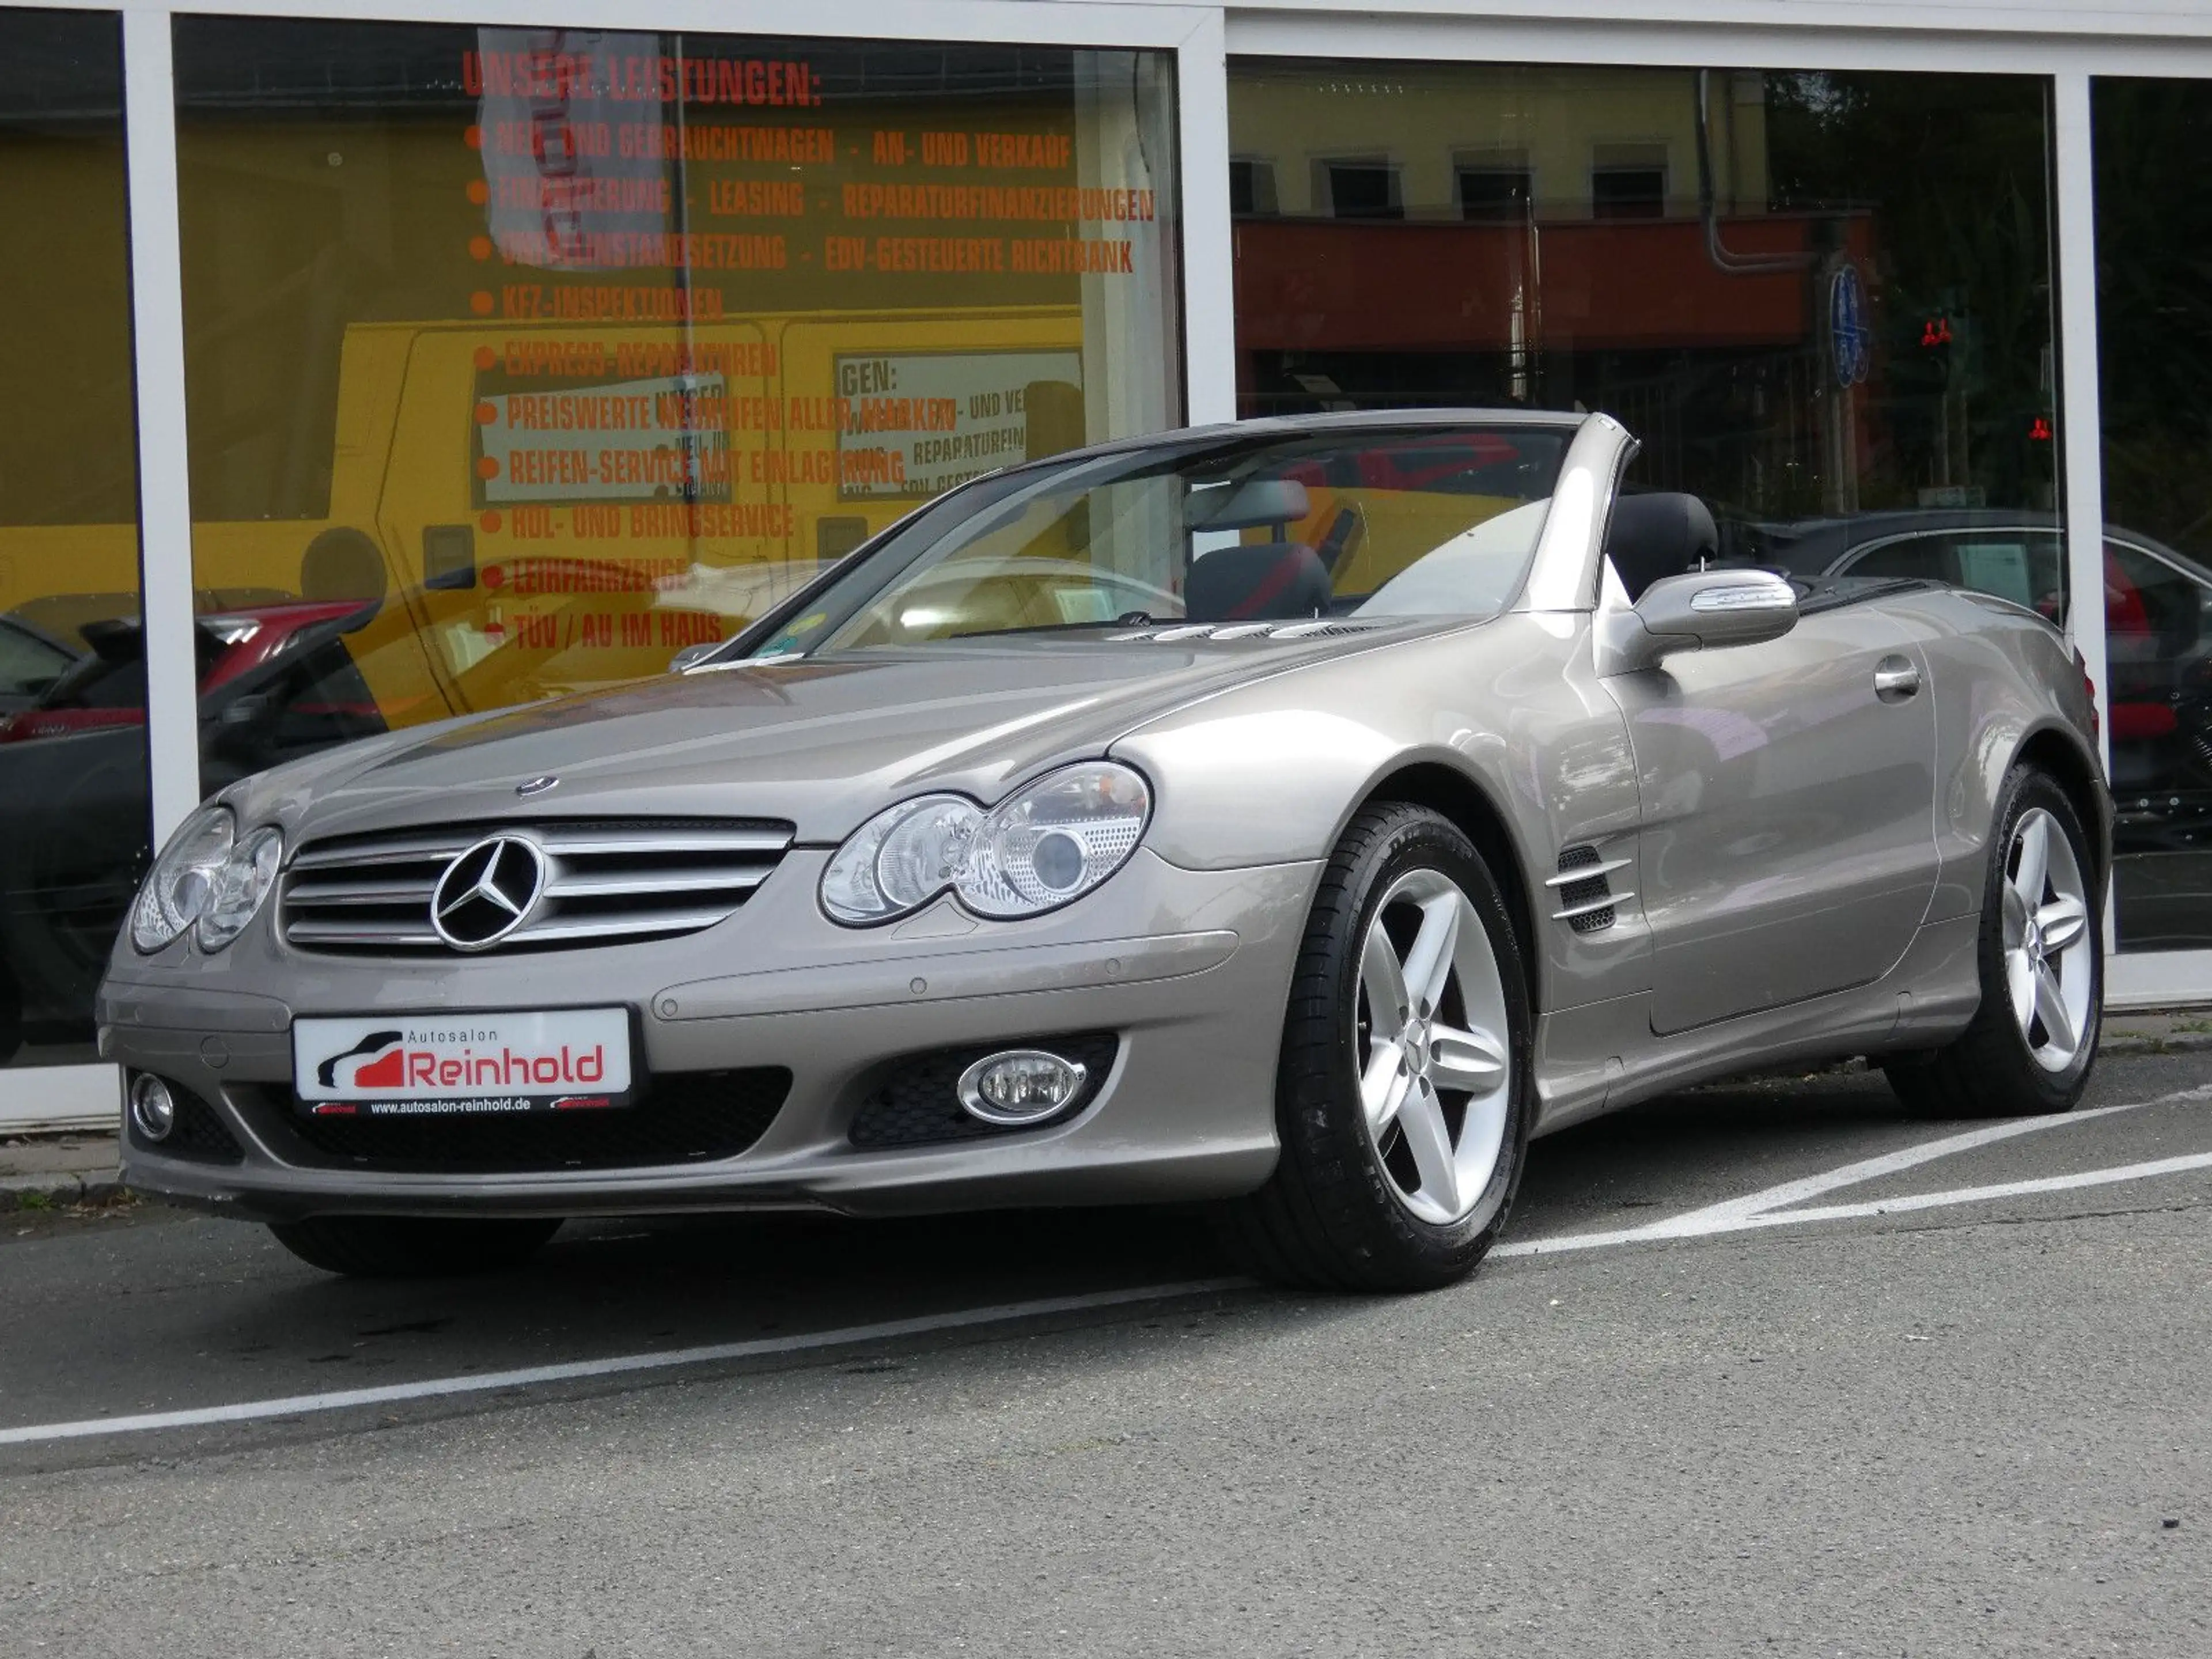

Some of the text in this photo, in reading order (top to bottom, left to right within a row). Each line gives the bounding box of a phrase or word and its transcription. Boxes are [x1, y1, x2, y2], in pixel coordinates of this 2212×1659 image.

[463, 51, 822, 106] UNSERE LEISTUNGEN:
[620, 123, 834, 164] GEBRAUCHTWAGEN
[873, 131, 914, 165] AN-
[923, 132, 968, 166] UND
[975, 134, 1070, 168] VERKAUF
[710, 180, 804, 216] LEASING
[842, 183, 1154, 221] REPARATURFINANZIERUNGEN
[825, 236, 1003, 271] EDV-GESTEUERTE
[1012, 239, 1132, 273] RICHTBANK
[503, 285, 723, 320] KFZ-INSPEKTIONEN
[505, 342, 777, 377] EXPRESS-REPARATUREN
[842, 359, 897, 396] GEN:
[507, 396, 650, 430] PREISWERTE
[790, 397, 851, 431] ALLER
[510, 449, 690, 484] REIFEN-SERVICE
[751, 450, 905, 484] EINLAGERUNG
[512, 503, 794, 538] HOL- UND BRINGSERVICE
[515, 605, 558, 650] TÜV
[582, 613, 612, 648] AU
[622, 613, 652, 647] IM
[661, 613, 722, 646] HAUS
[408, 1029, 498, 1043] Autosalon
[409, 1045, 604, 1087] Reinhold
[370, 1099, 531, 1115] www.autosalon-reinhold.de
